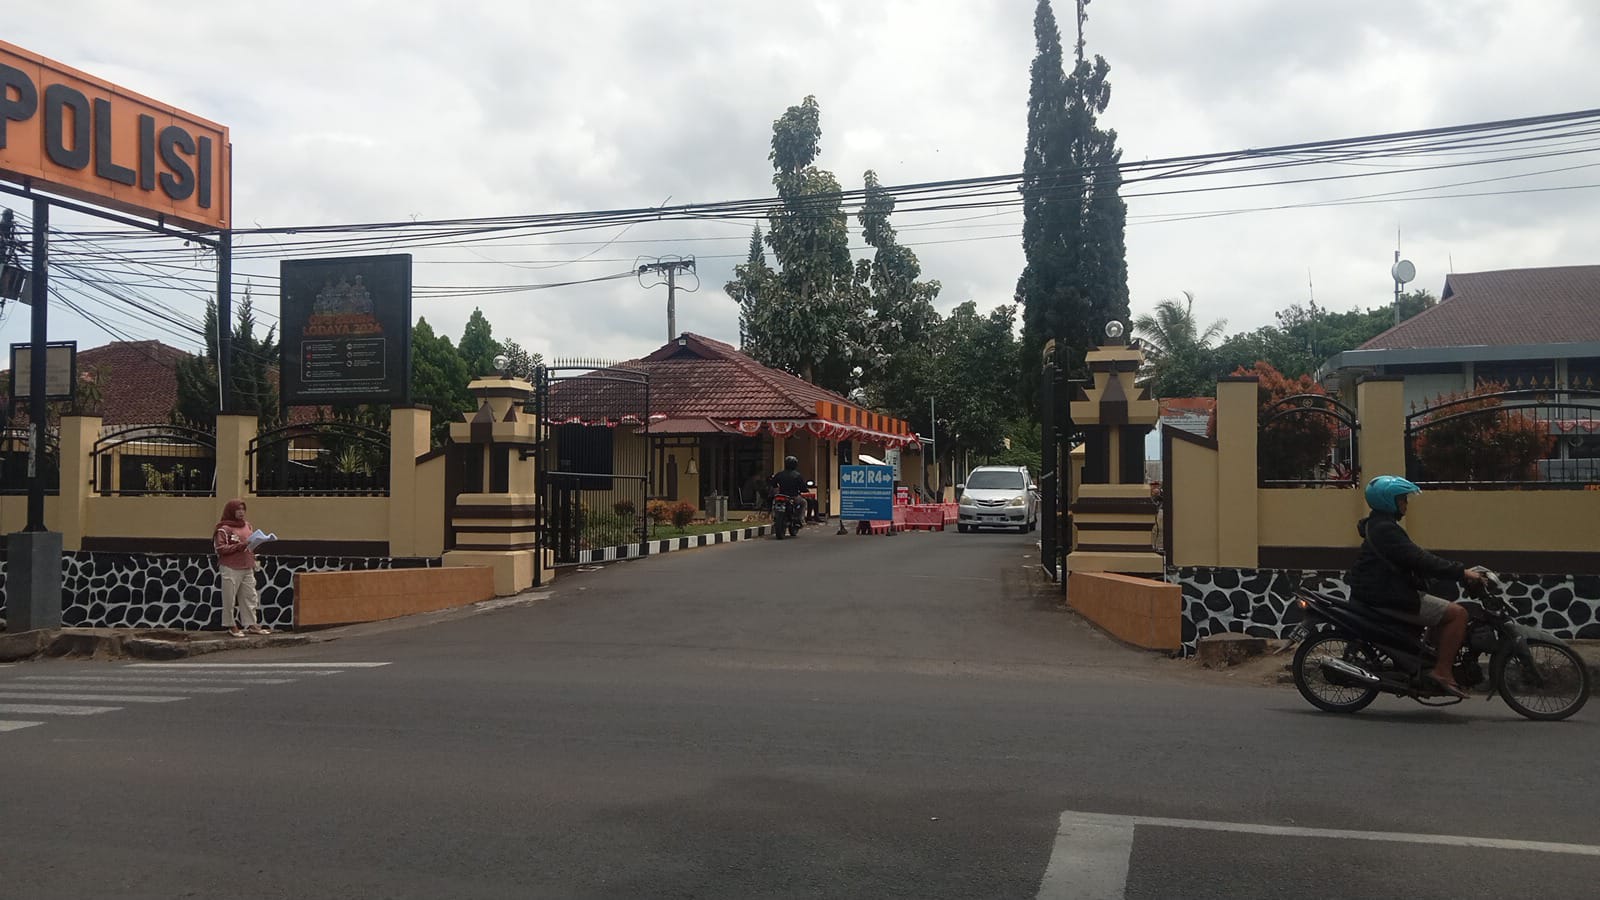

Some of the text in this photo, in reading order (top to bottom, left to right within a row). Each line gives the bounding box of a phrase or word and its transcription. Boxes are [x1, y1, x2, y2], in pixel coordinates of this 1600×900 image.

[0, 62, 211, 208] POLISI
[851, 470, 865, 483] R2
[867, 470, 882, 483] R4
